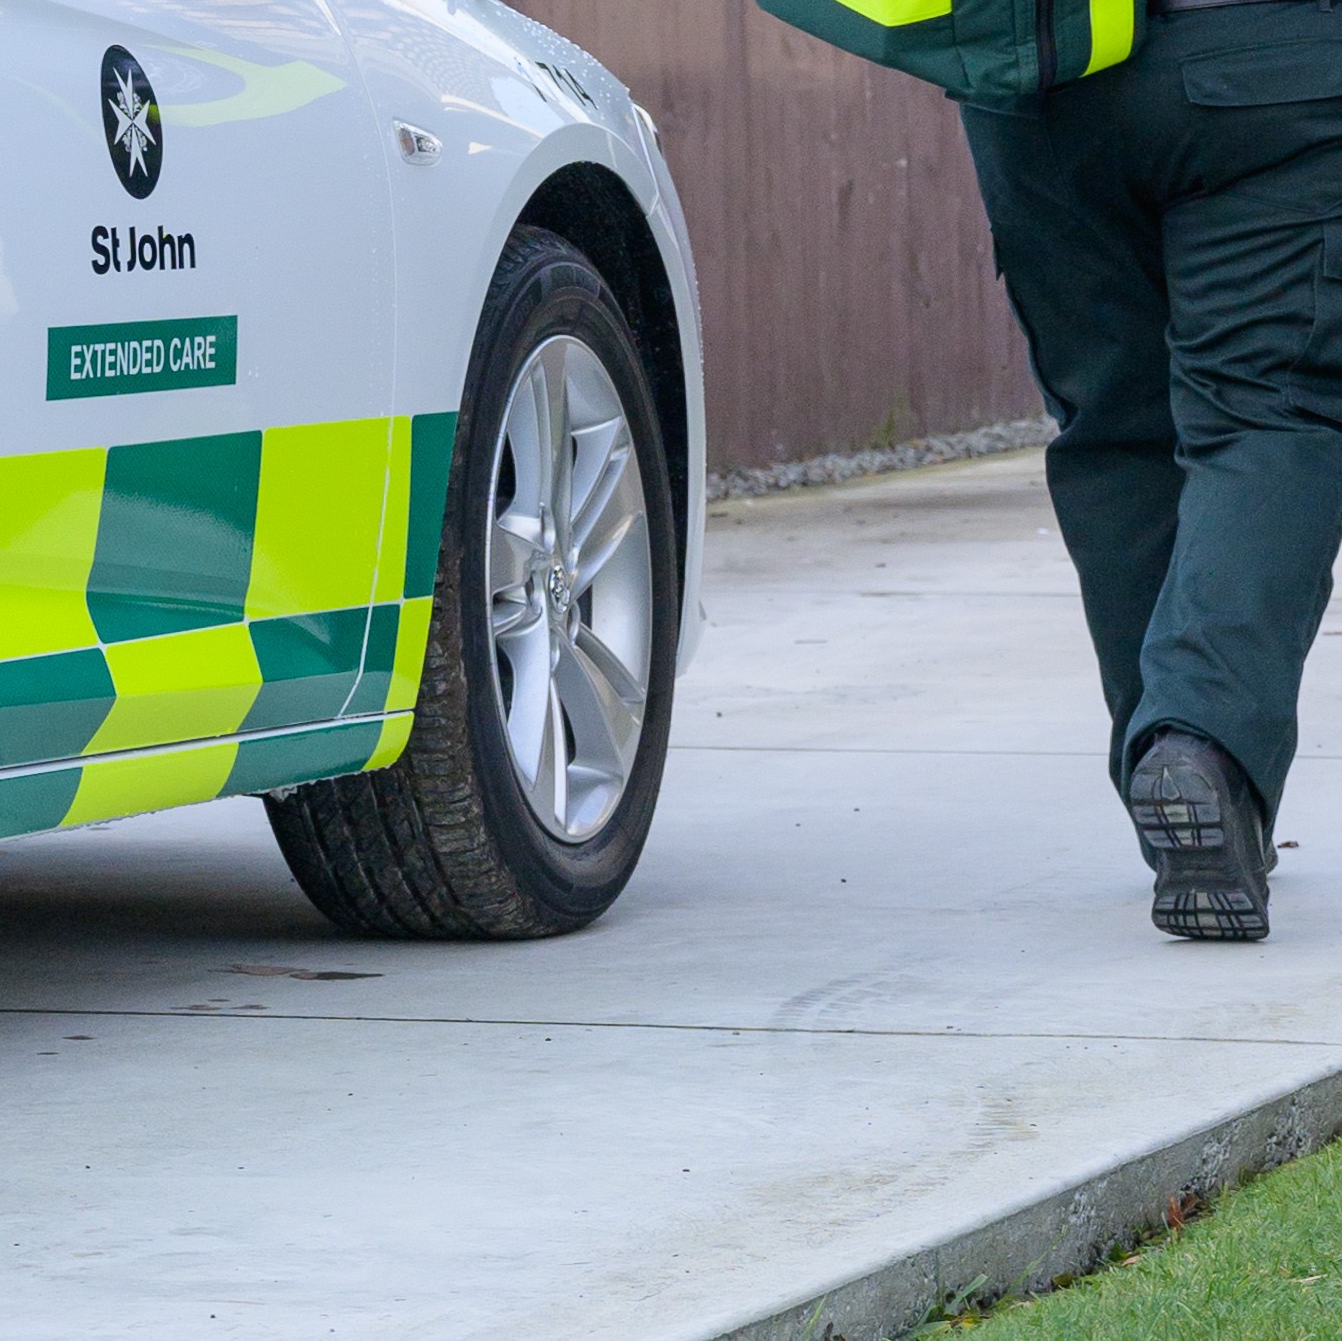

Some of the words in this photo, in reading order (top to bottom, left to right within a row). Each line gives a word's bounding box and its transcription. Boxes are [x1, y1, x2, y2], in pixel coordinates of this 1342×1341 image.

[91, 225, 121, 275] St
[127, 225, 196, 273] John
[70, 339, 165, 380] EXTENDED
[169, 335, 216, 372] CARE
